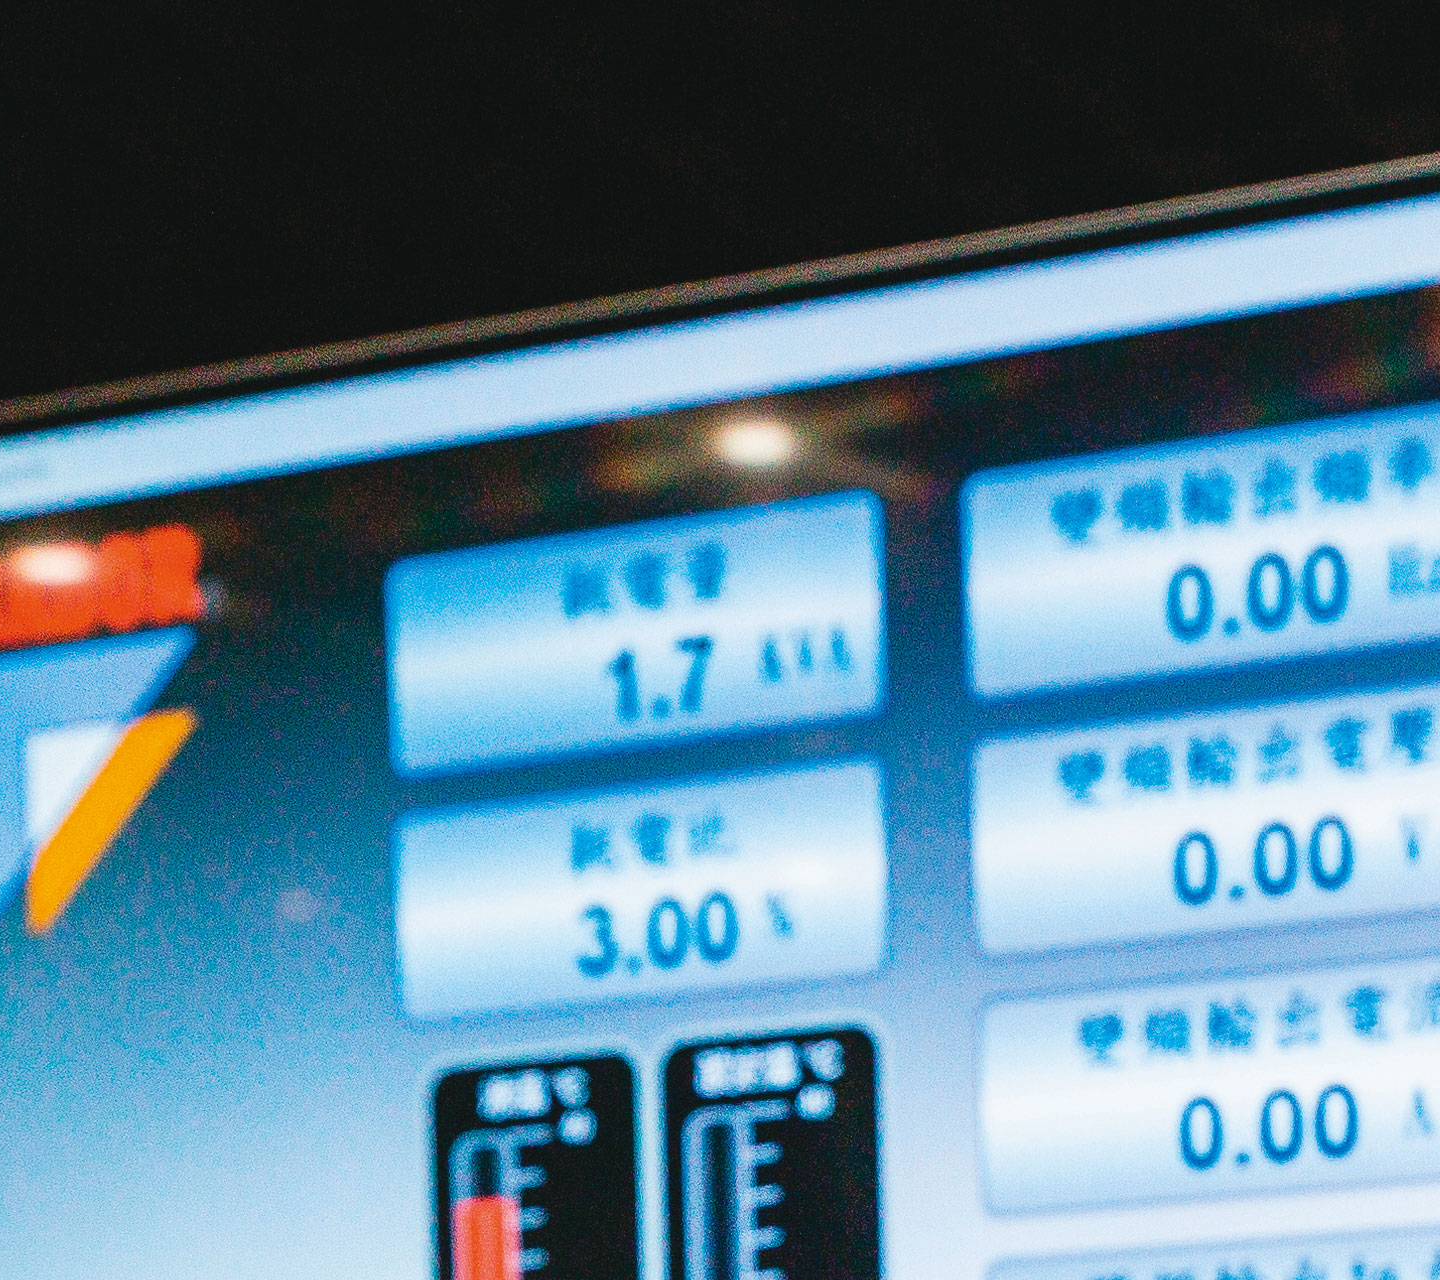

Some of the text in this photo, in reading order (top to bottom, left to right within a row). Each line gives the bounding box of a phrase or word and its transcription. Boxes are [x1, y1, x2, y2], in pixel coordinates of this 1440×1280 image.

[1166, 544, 1350, 643] 0.00
[606, 634, 714, 722] 1.7
[1173, 815, 1354, 908] 0.00
[575, 889, 740, 978] 3.00
[1179, 1083, 1360, 1171] 0.00
